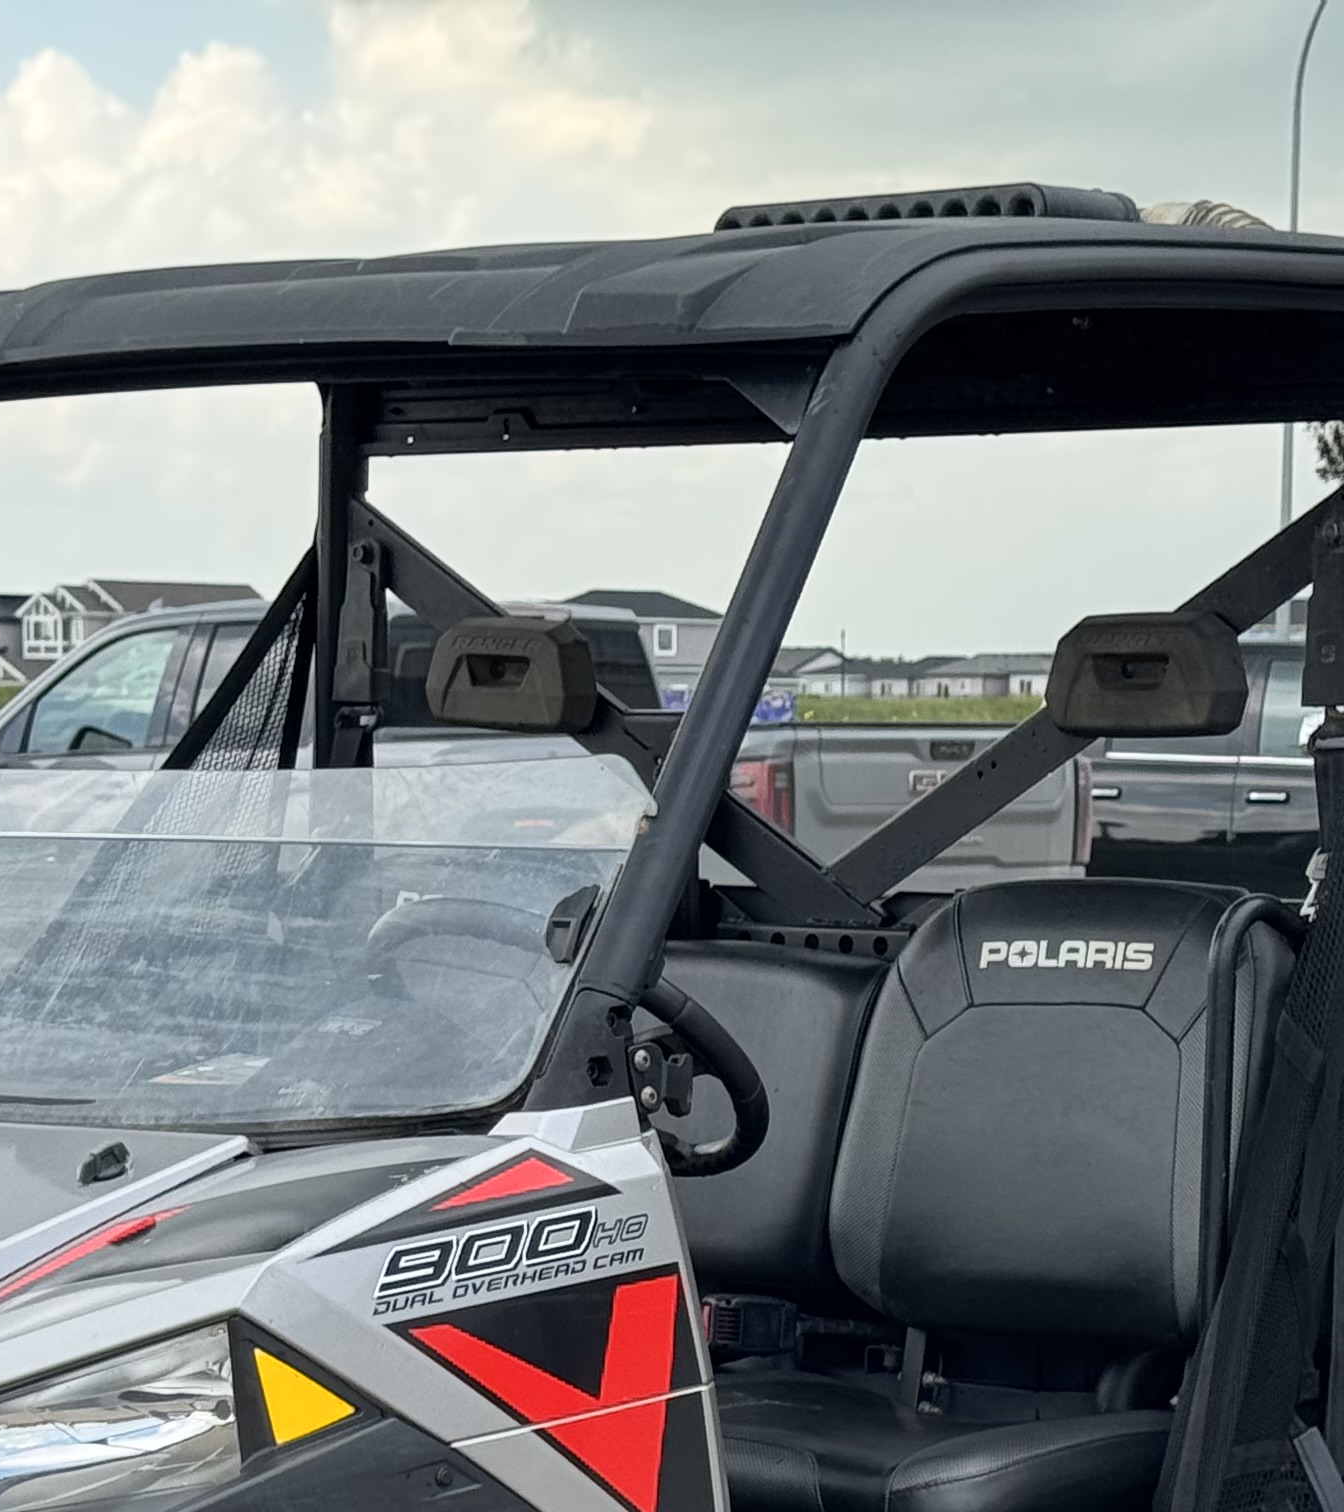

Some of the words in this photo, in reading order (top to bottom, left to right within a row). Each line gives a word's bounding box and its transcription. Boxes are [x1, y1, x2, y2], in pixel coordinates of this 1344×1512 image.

[979, 939, 1155, 971] POLARIS
[372, 1205, 597, 1299] 900
[372, 1290, 444, 1317] DUAL
[451, 1259, 586, 1301] OVERHEAD
[592, 1247, 645, 1272] CAM
